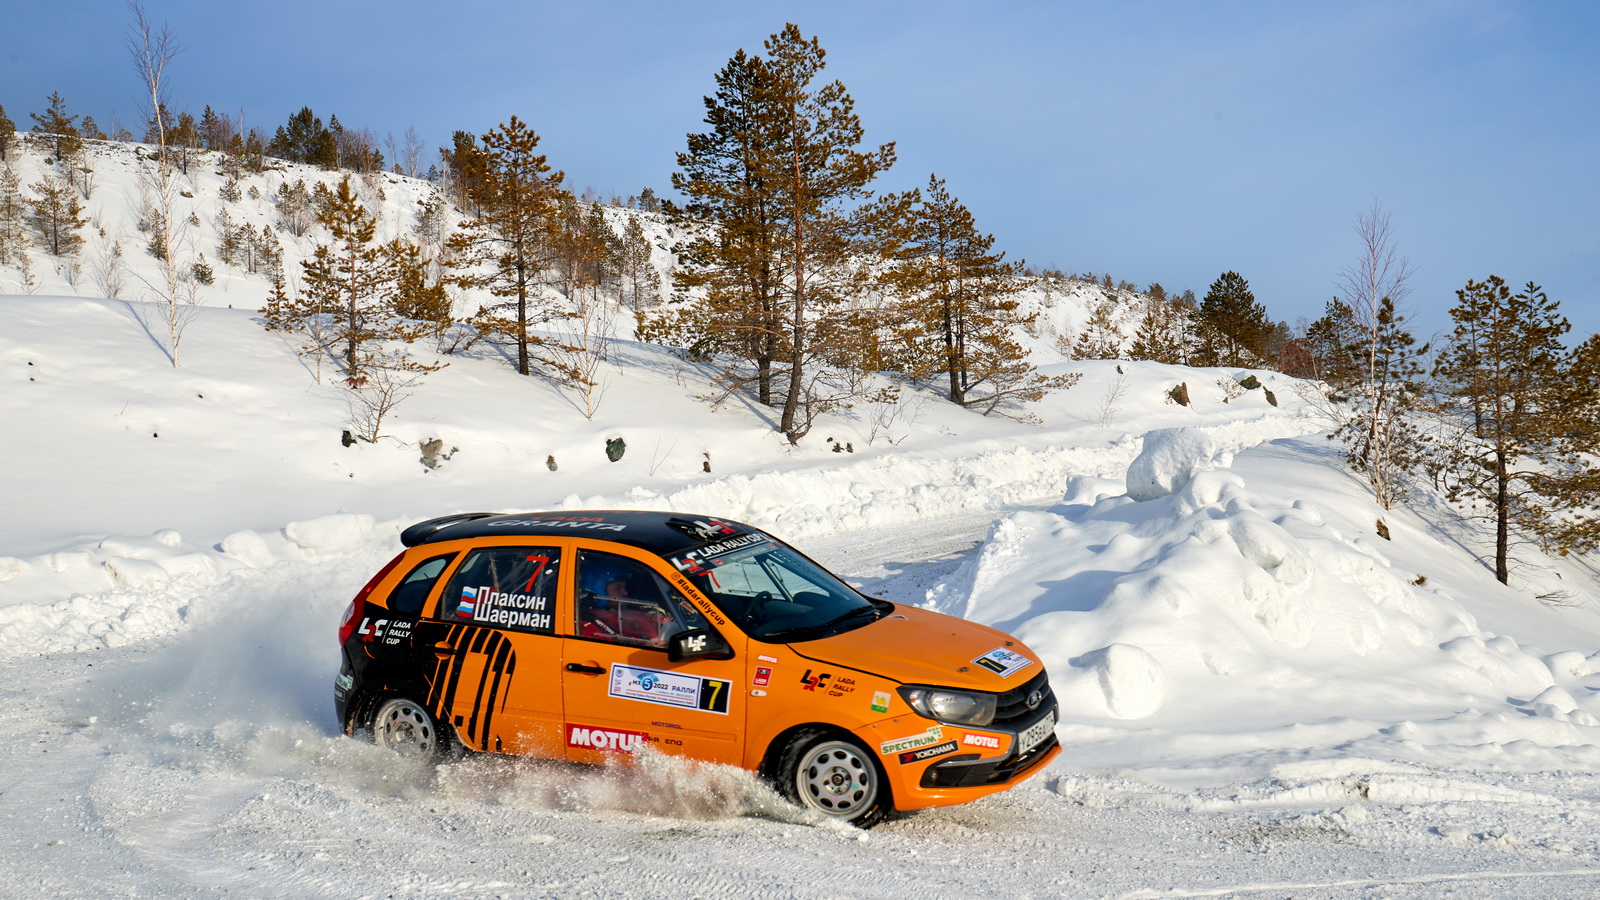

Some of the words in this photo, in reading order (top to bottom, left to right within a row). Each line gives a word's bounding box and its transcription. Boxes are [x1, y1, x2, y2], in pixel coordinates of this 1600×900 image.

[487, 519, 627, 532] GRANTA
[697, 543, 726, 557] LADA
[724, 535, 751, 550] RALLY
[525, 555, 550, 592] 7
[697, 570, 721, 588] 7
[477, 586, 546, 610] Плаксин
[677, 578, 726, 626] #ladarallycup
[474, 603, 551, 628] Шаерман
[393, 620, 412, 629] LADA
[389, 629, 411, 638] RALLY
[653, 682, 669, 691] 2022
[671, 685, 696, 695] РАЛЛИ
[833, 684, 855, 693] RALLY
[837, 677, 855, 686] LADA
[708, 680, 723, 710] 7
[828, 690, 843, 698] CUP
[882, 735, 938, 755] SPECTRUM
[963, 734, 1000, 749] MOTUL
[915, 743, 956, 760] YOKOHAMA
